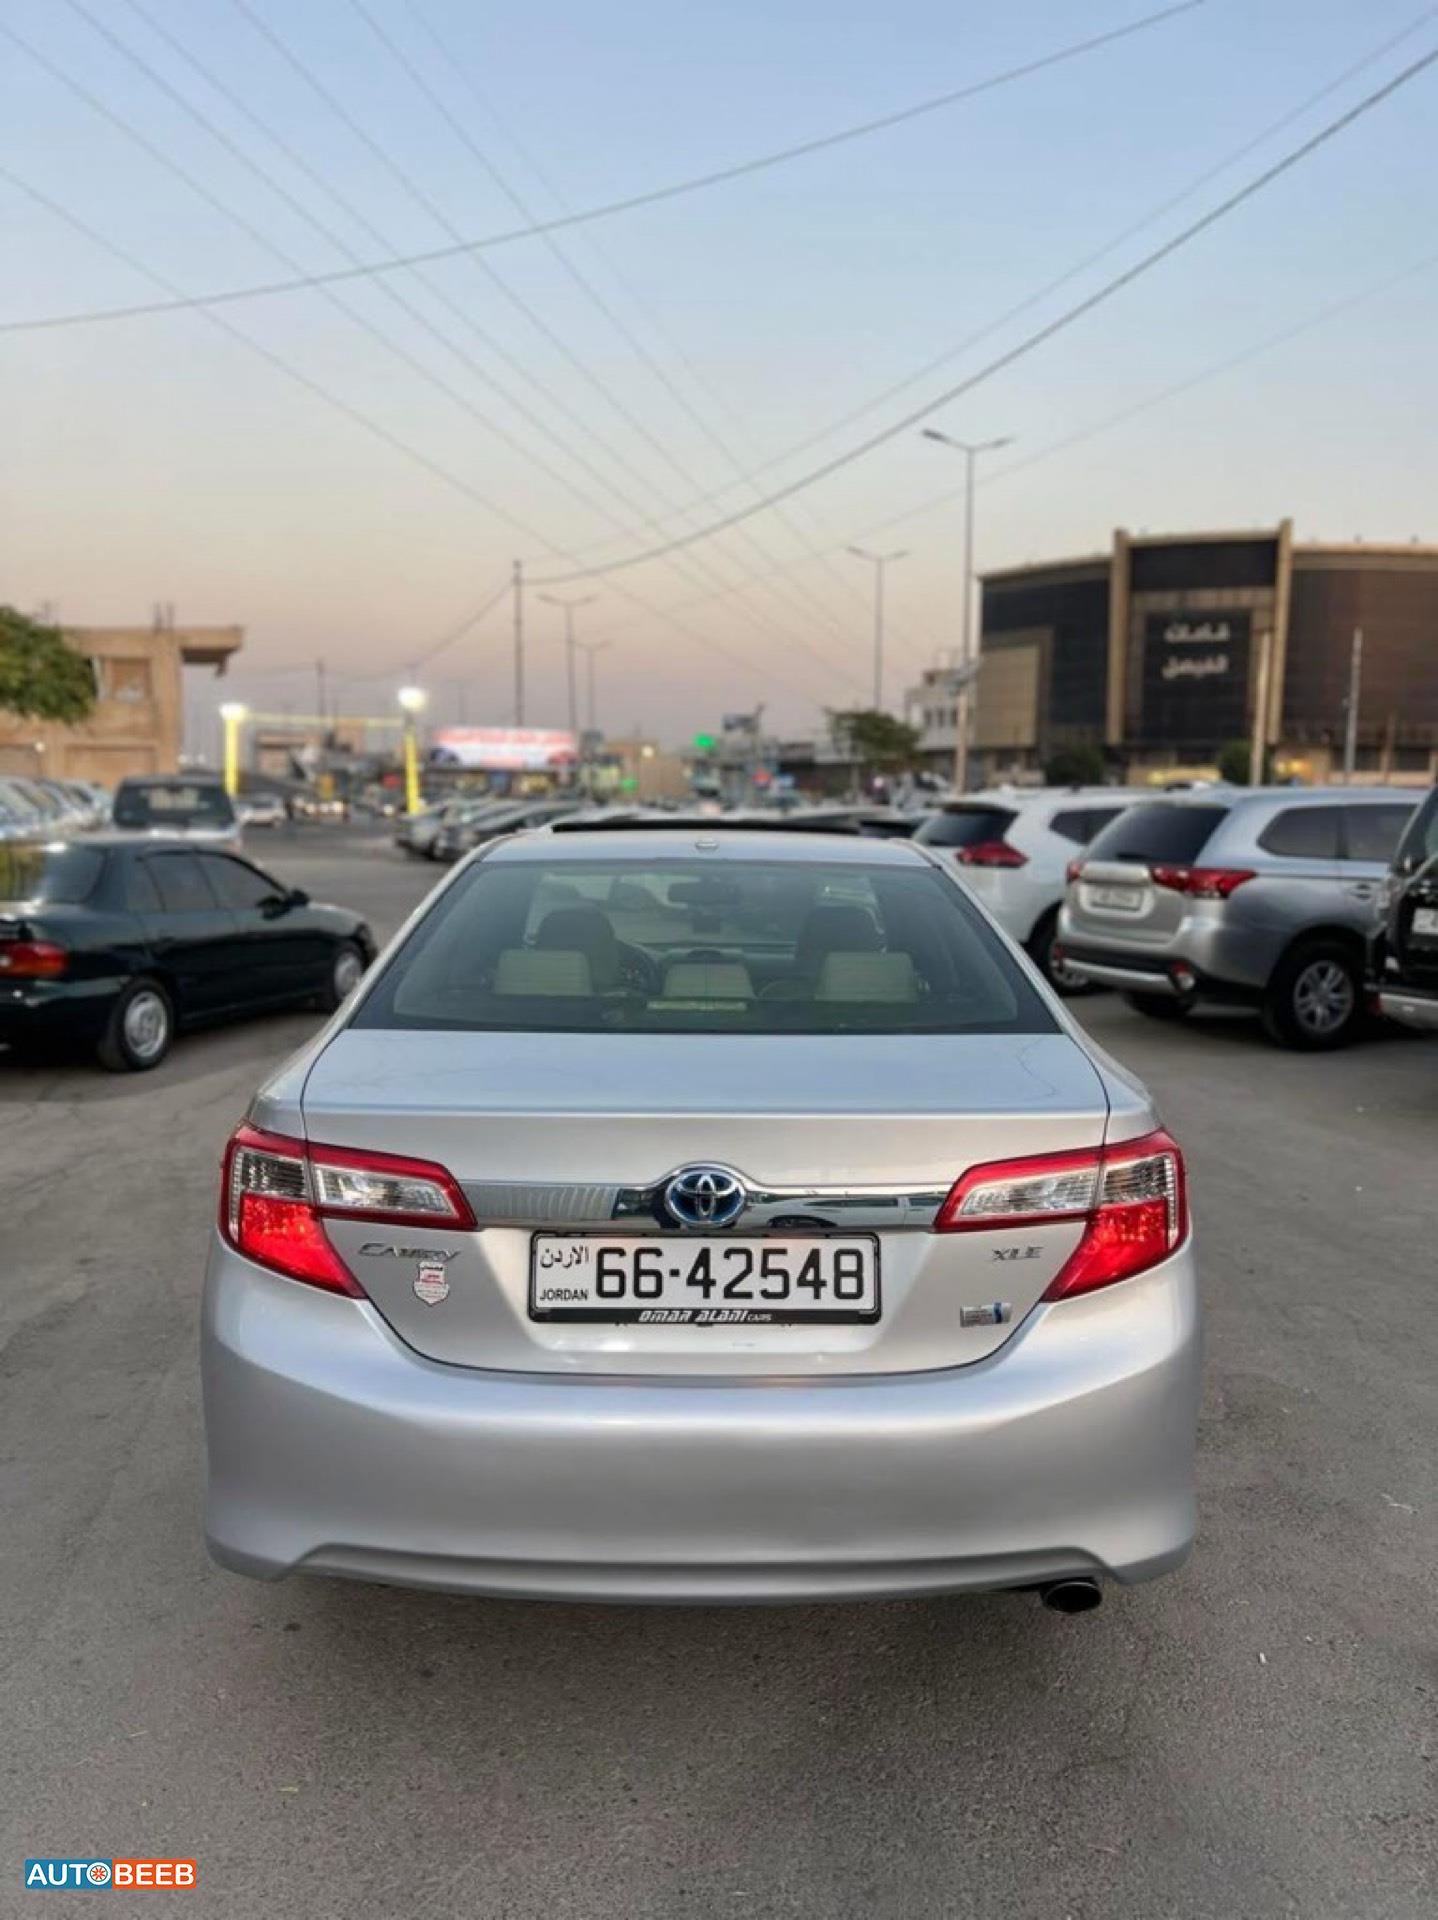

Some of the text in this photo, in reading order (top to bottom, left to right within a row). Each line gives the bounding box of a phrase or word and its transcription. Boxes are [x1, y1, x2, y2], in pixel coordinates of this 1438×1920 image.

[358, 1242, 461, 1262] CAMRY
[992, 1246, 1045, 1261] XLE
[595, 1246, 864, 1300] 66-42548
[539, 1288, 589, 1301] JORDAN
[638, 1310, 692, 1323] OMAR
[694, 1310, 748, 1323] ALANI
